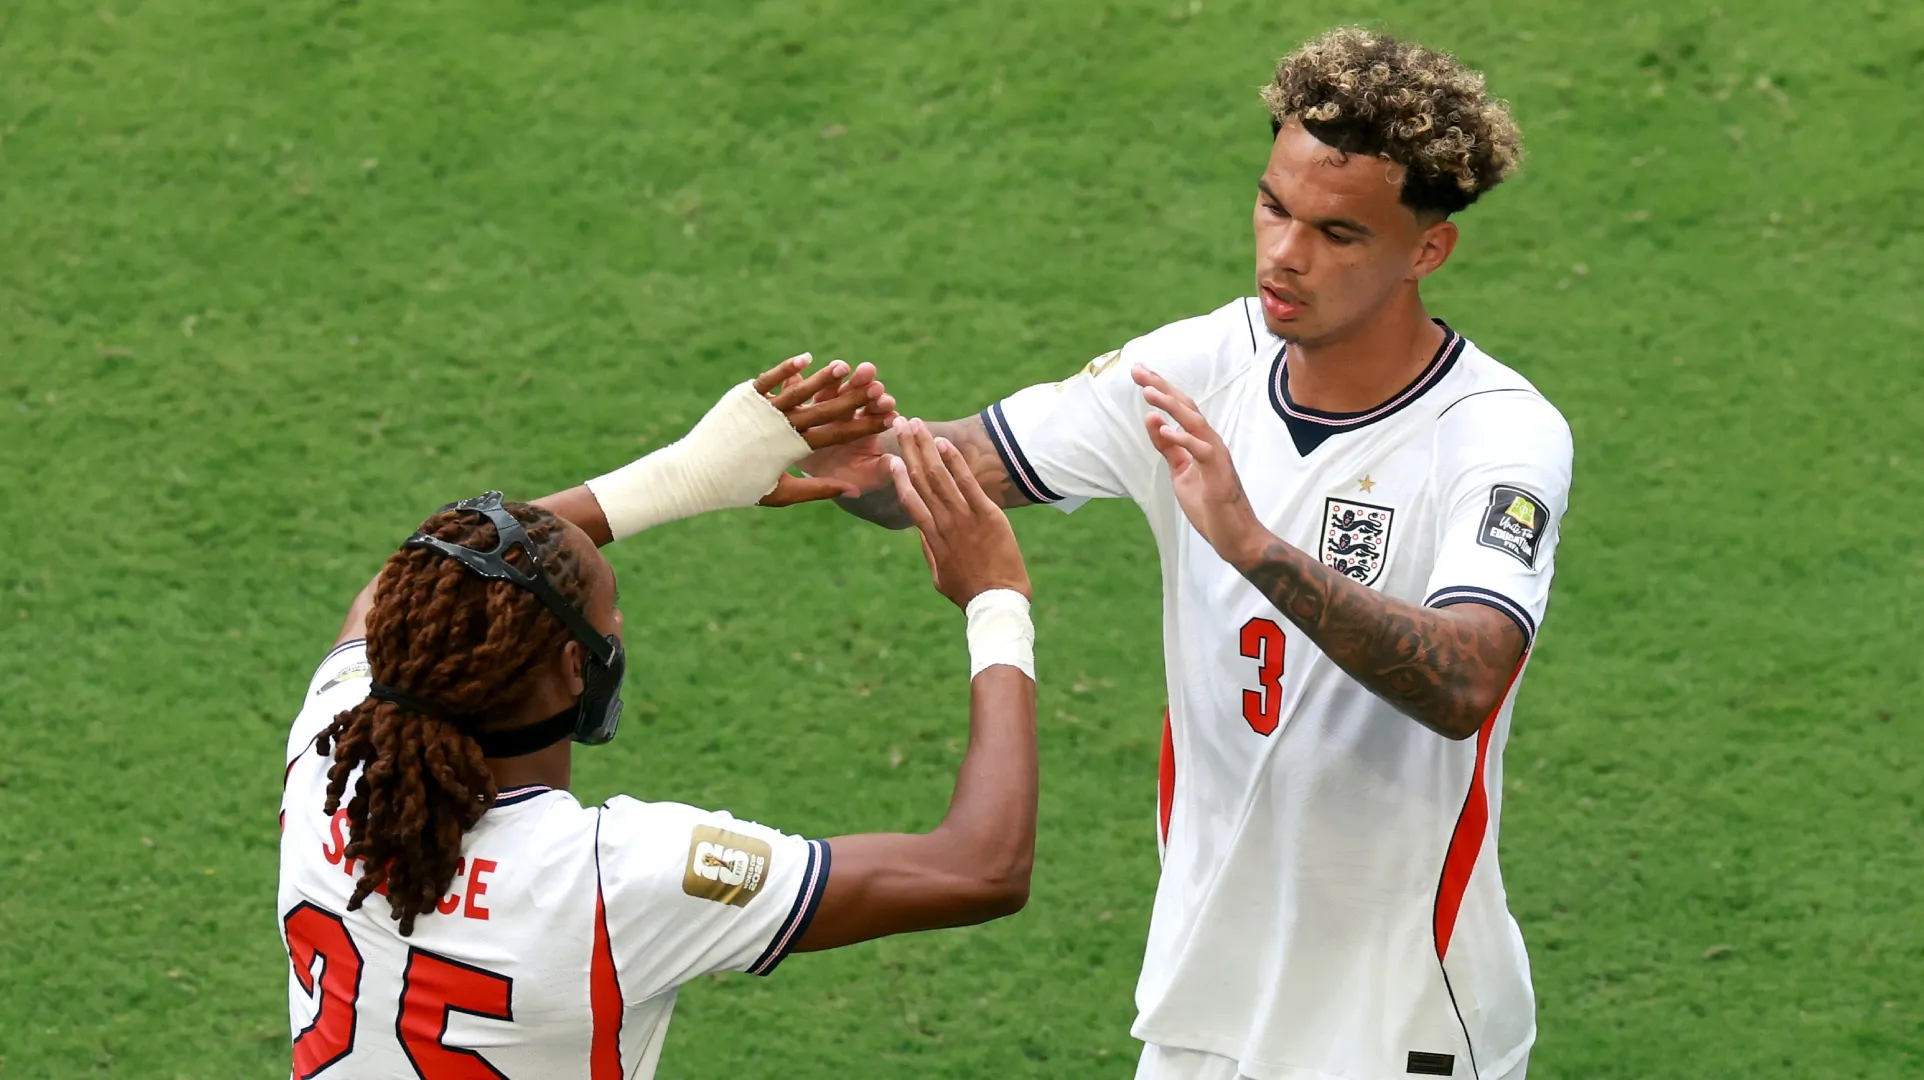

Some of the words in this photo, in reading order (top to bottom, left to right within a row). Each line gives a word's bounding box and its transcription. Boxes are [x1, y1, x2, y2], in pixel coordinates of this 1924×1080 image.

[1240, 617, 1286, 737] 3
[735, 860, 744, 876] FIFA
[744, 867, 754, 889] WORLD
[748, 856, 764, 891] 2026
[283, 899, 514, 1080] 25
